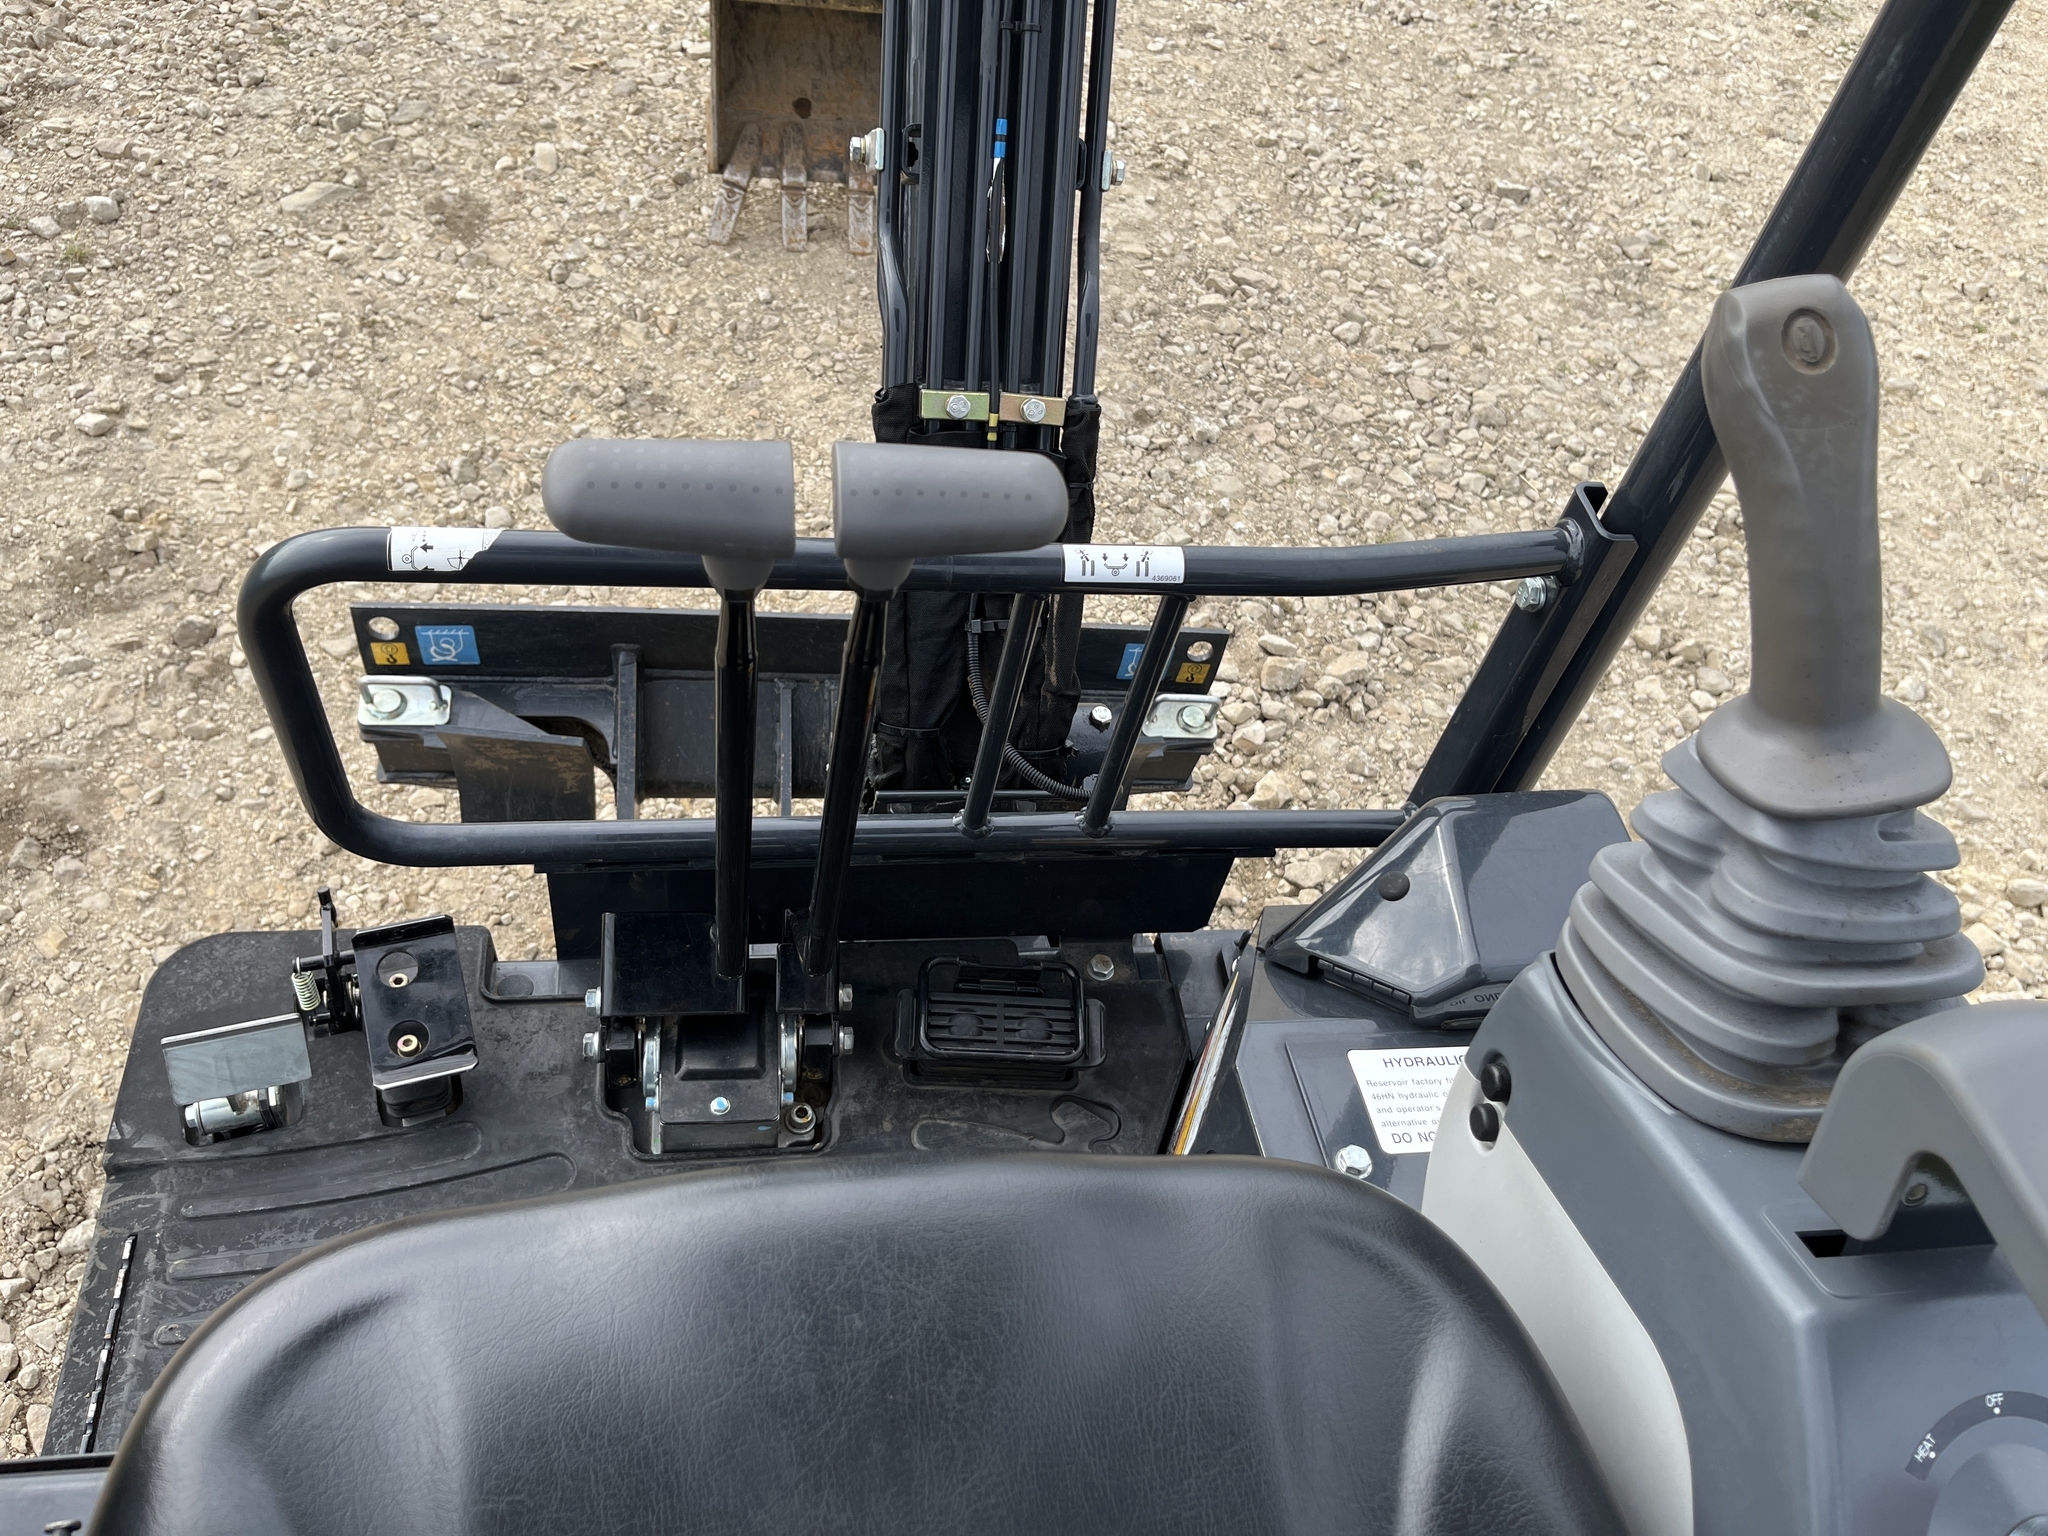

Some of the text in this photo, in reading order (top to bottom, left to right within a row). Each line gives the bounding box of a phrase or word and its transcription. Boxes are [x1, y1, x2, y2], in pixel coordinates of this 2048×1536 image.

[1366, 1079, 1408, 1087] Reservoir
[1411, 1077, 1442, 1086] factory
[1371, 1092, 1395, 1101] 46HN
[1398, 1091, 1439, 1101] hydraulic
[1376, 1104, 1441, 1114] and operator's
[1381, 1118, 1428, 1128] alternative
[1391, 1132, 1412, 1144] DO
[1985, 1392, 2005, 1408] OFF
[1914, 1432, 1936, 1463] HEAT
